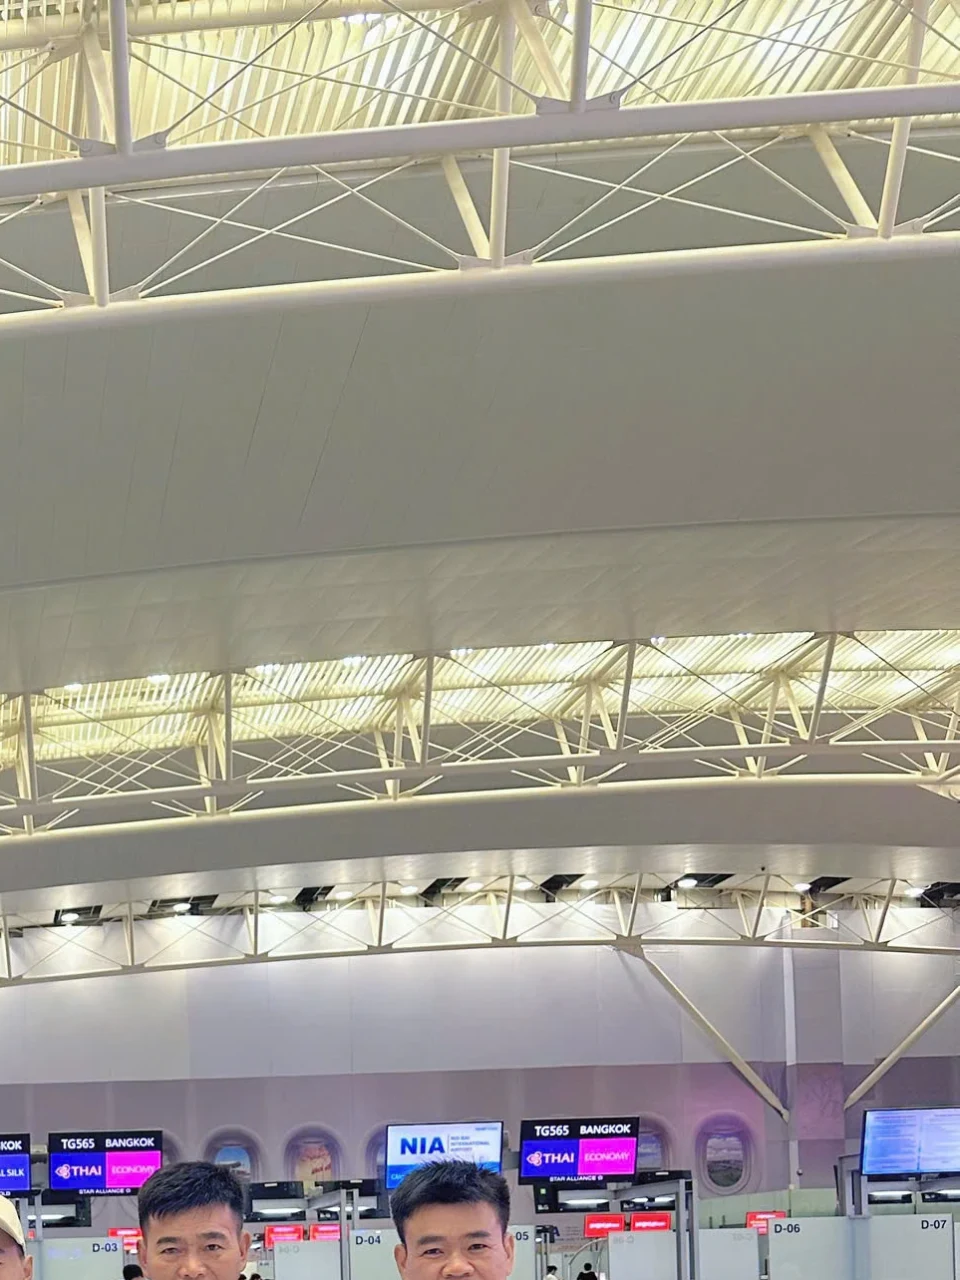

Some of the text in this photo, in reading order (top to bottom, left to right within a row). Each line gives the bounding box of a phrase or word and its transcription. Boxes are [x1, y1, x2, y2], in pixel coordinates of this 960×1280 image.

[534, 1123, 631, 1137] TG565 BANGKOK
[61, 1138, 155, 1149] TG565 BANGKOK
[400, 1137, 445, 1155] NIA
[544, 1153, 574, 1163] THAI
[584, 1152, 630, 1162] ECONOMY
[7, 1168, 25, 1178] SILK
[71, 1166, 102, 1176] THAI
[774, 1223, 801, 1233] D-06
[921, 1219, 947, 1229] D-07
[355, 1235, 381, 1245] D-04
[515, 1231, 529, 1241] -05
[92, 1243, 118, 1253] D-03
